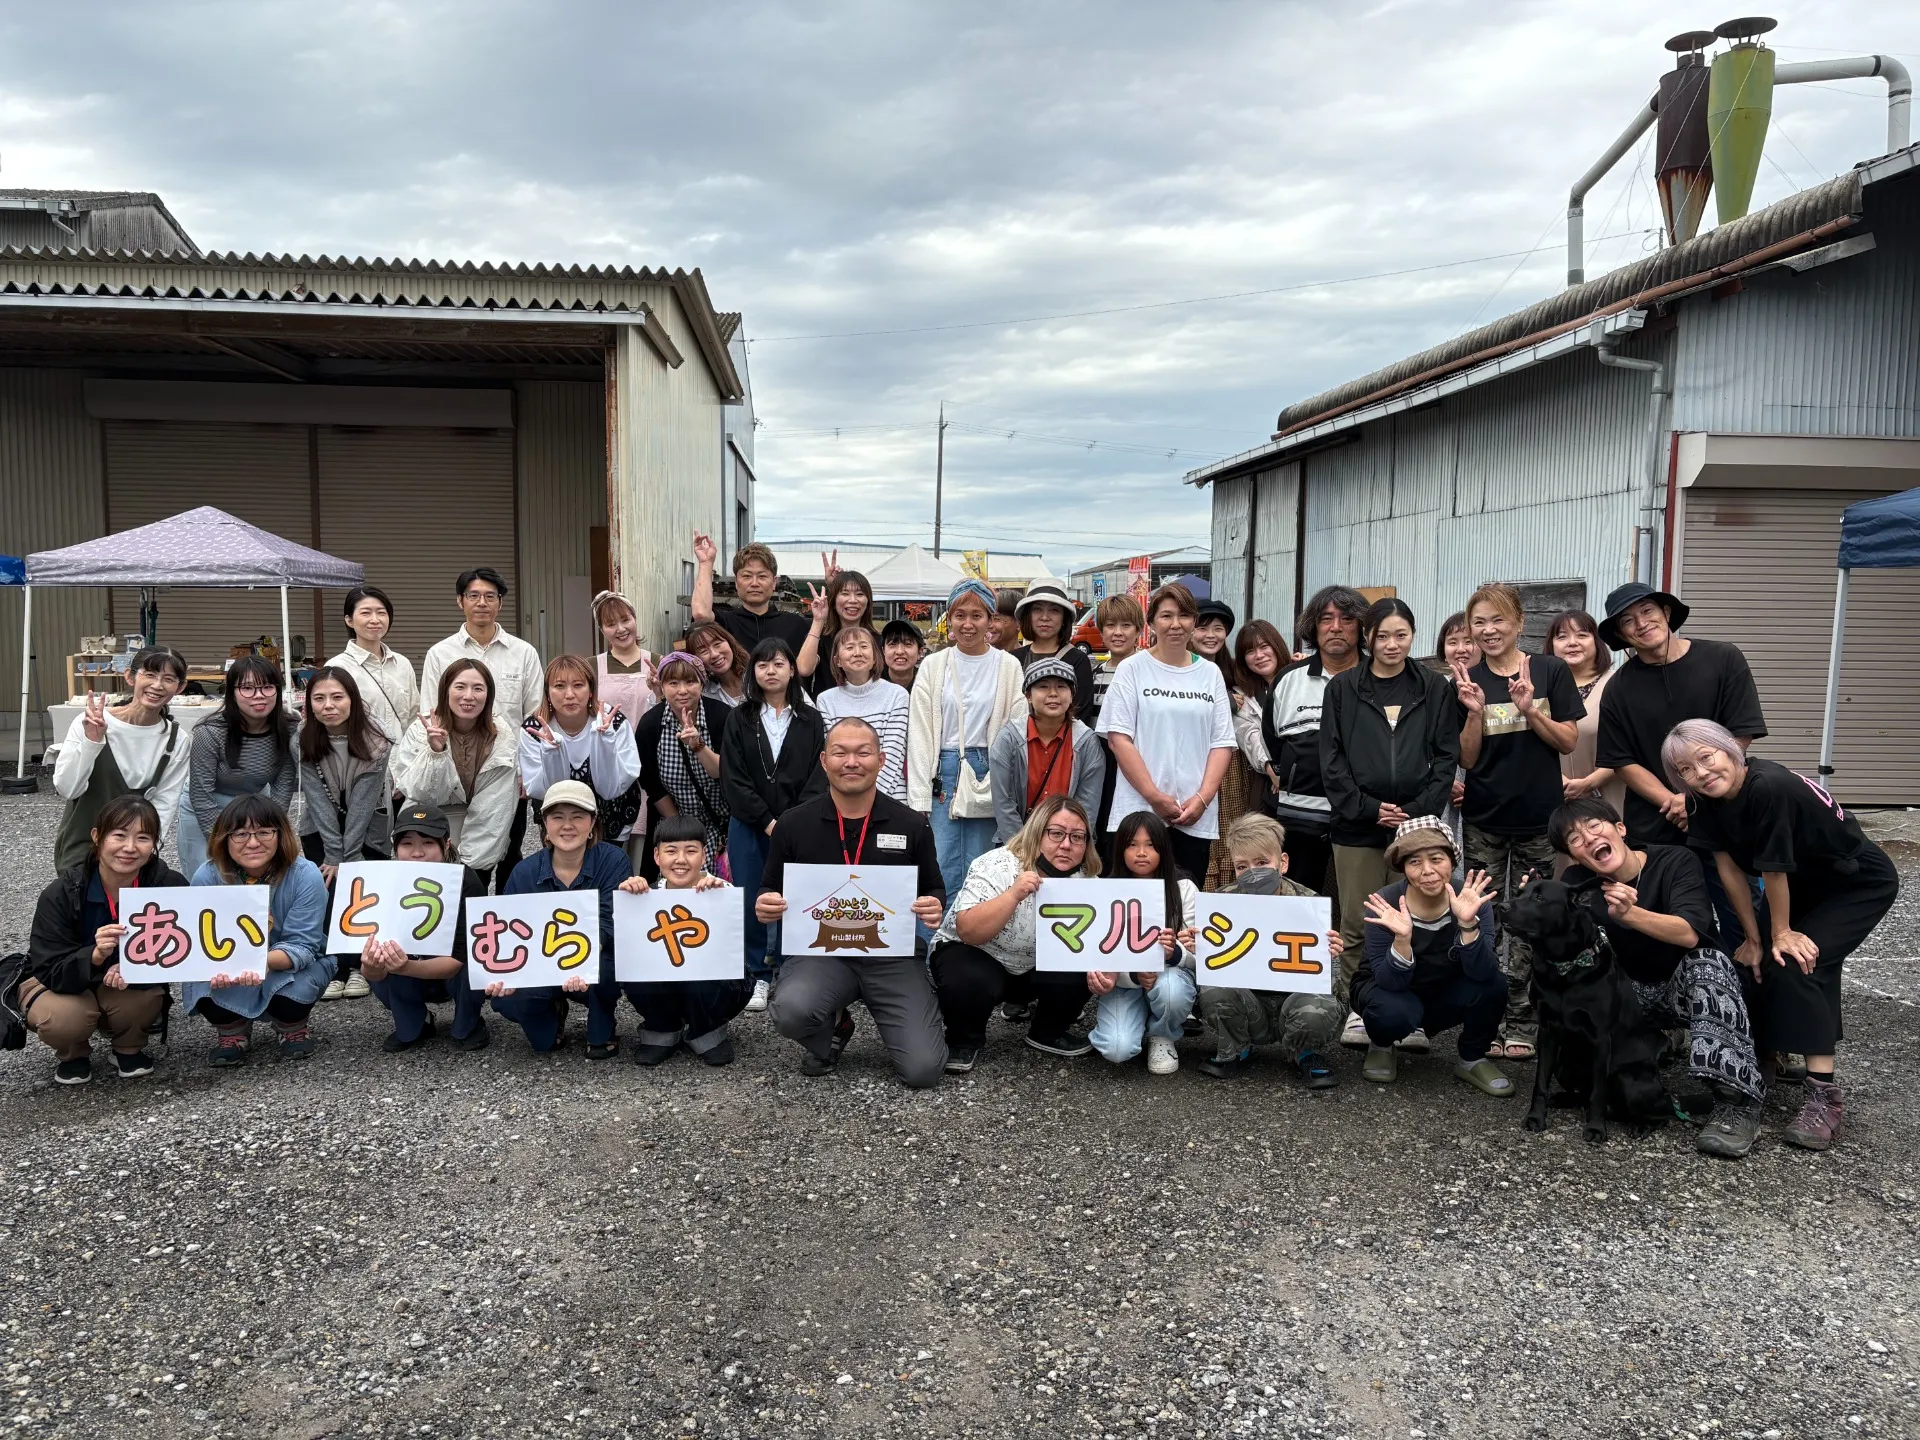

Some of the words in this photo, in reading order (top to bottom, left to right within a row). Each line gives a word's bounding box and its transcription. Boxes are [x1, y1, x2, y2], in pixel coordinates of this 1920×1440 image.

[1142, 687, 1215, 704] COWABUNGA
[339, 876, 444, 941] とう
[811, 908, 885, 921] むらやマルシェ
[828, 897, 869, 909] あいとう
[1038, 898, 1162, 955] マル
[124, 901, 266, 969] あい
[470, 908, 592, 974] むら
[646, 904, 710, 968] や
[831, 933, 866, 942] 村山製材所
[1201, 911, 1324, 975] シェ
